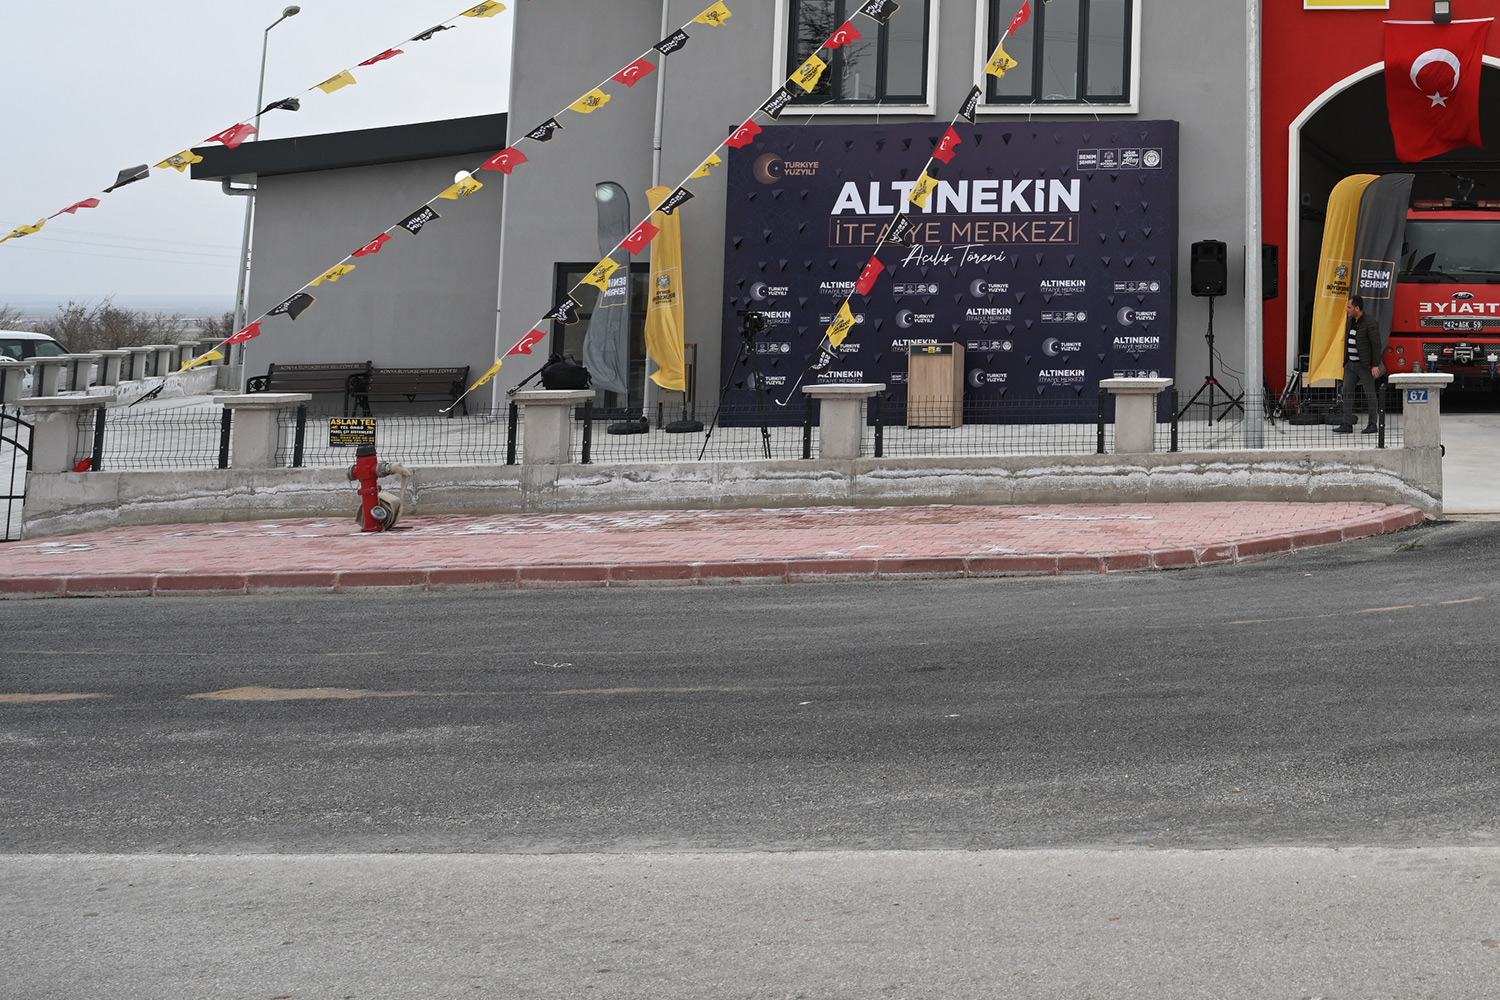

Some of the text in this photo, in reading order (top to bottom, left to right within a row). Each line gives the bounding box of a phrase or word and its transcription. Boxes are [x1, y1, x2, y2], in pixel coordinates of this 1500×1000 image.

[836, 220, 941, 244] İTFAYE
[951, 217, 1073, 242] MERKEZİ
[901, 244, 953, 267] Açılış
[1361, 269, 1390, 280] BENİM
[1360, 280, 1389, 289] ŞEHRİM
[1447, 320, 1455, 328] 42
[1411, 391, 1425, 400] 67
